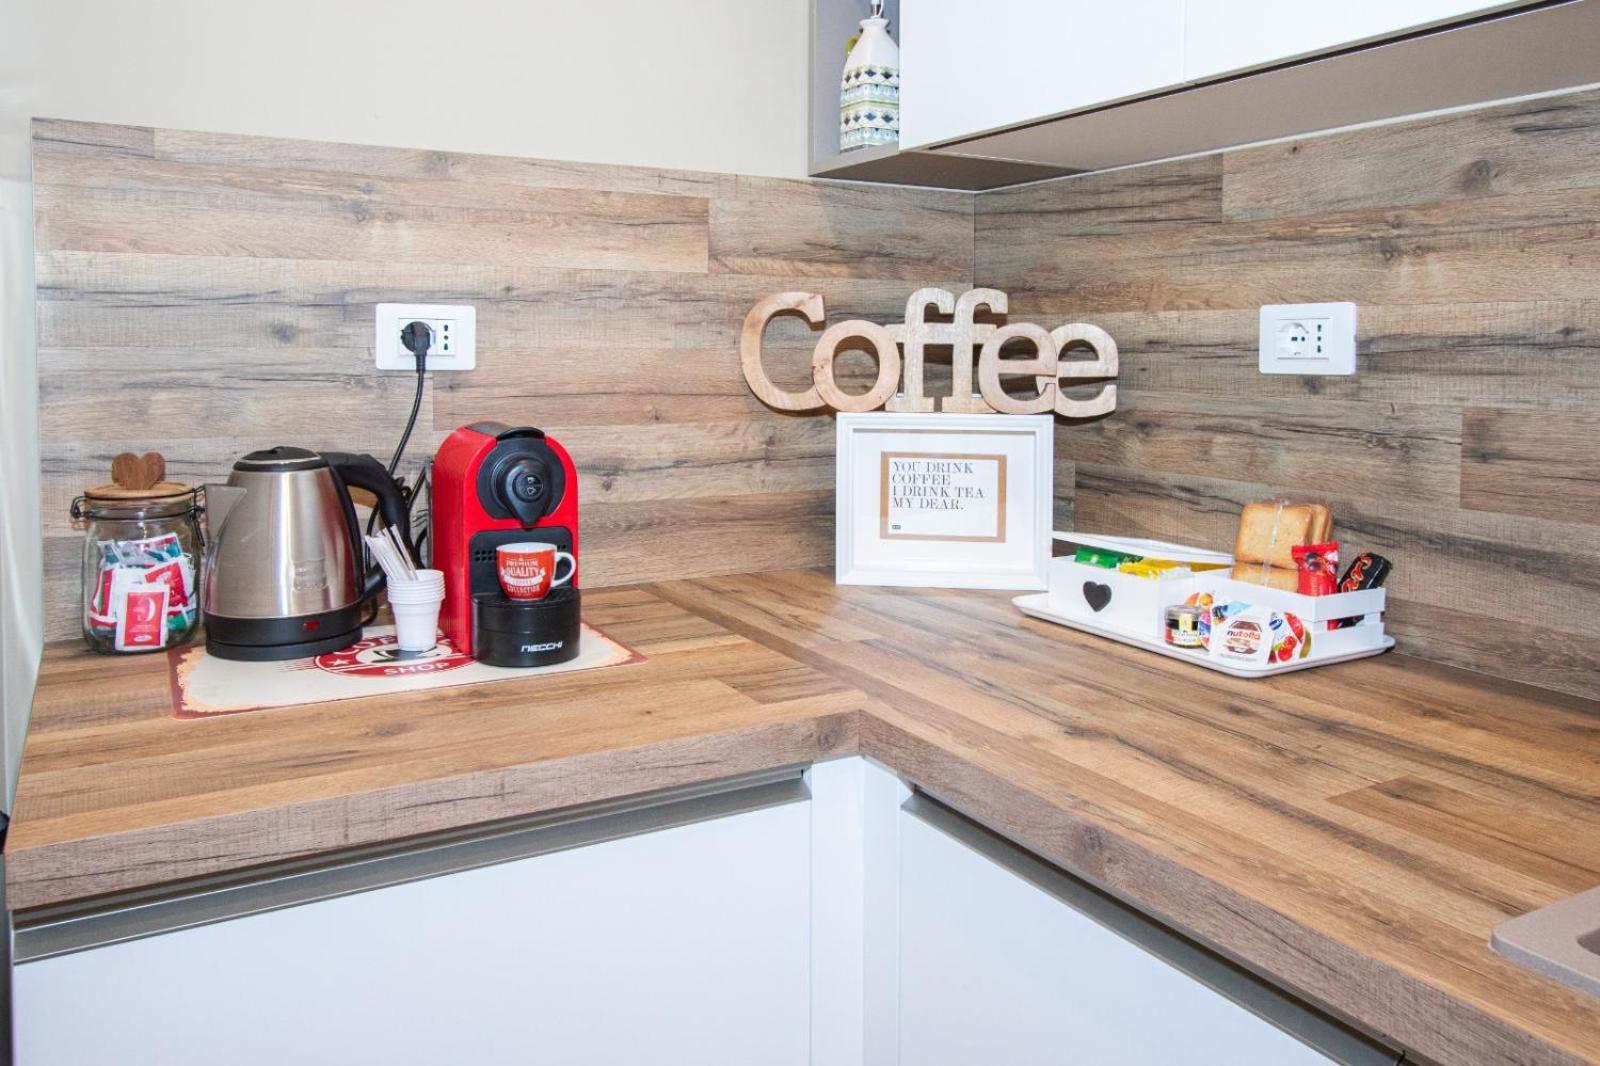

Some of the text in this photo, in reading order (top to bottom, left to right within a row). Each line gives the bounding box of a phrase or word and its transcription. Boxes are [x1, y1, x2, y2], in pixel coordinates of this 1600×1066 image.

[740, 287, 1119, 418] Coffee
[893, 461, 974, 474] YOU DRINK
[892, 473, 951, 486] COFFEE
[902, 486, 950, 498] DRINK
[954, 487, 985, 499] TEA
[892, 497, 965, 511] MY DEAR.
[505, 566, 539, 577] QUALITY
[1227, 630, 1261, 640] nutella
[521, 640, 563, 653] NECCHI
[383, 662, 449, 676] SHOP
